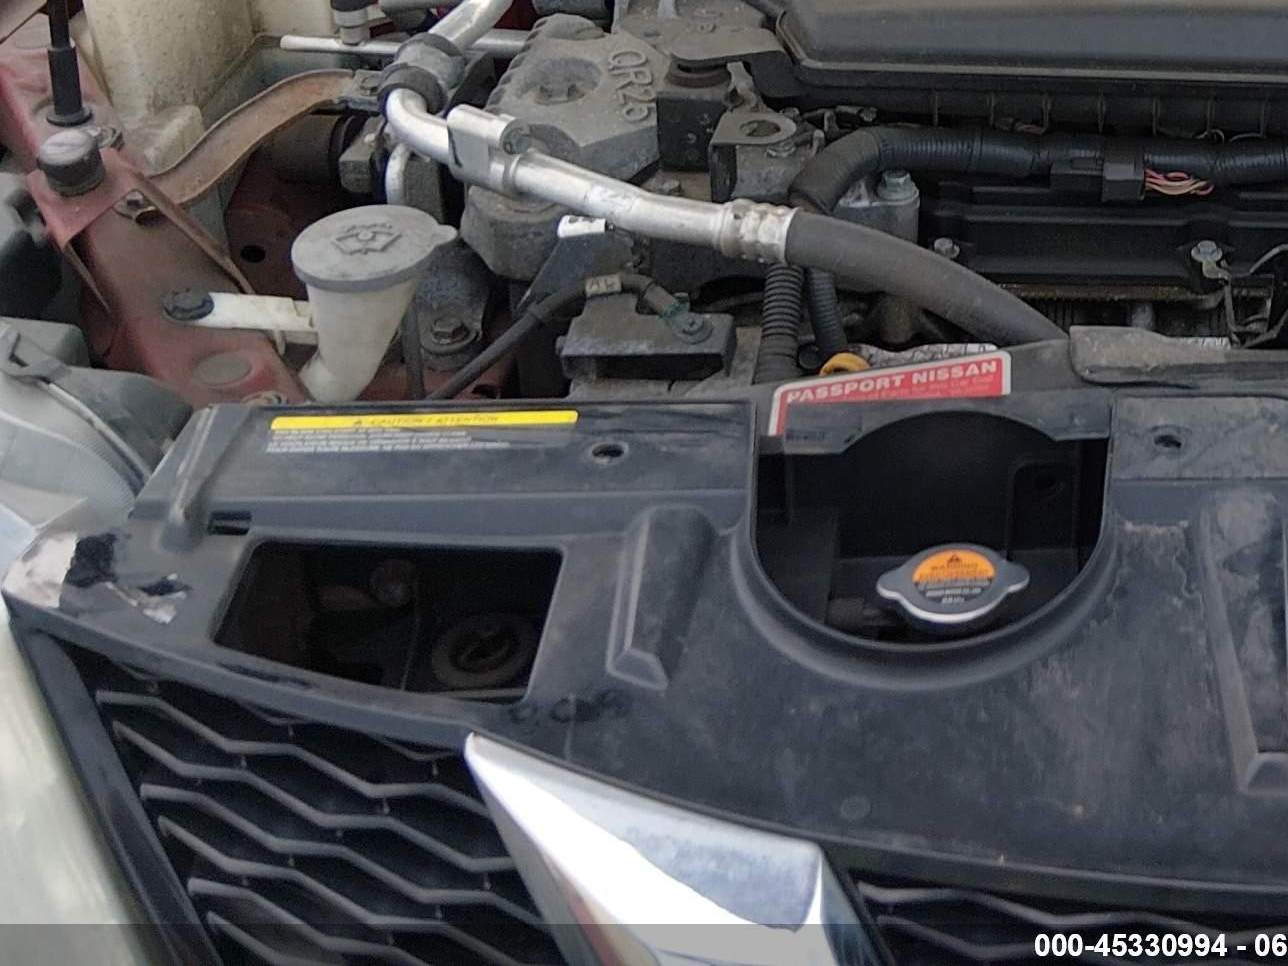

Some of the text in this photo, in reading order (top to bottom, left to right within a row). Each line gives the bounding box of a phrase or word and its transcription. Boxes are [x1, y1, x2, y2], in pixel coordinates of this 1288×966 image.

[608, 50, 657, 123] QR25
[786, 375, 905, 404] PASSPORT
[912, 360, 998, 384] NISSAN
